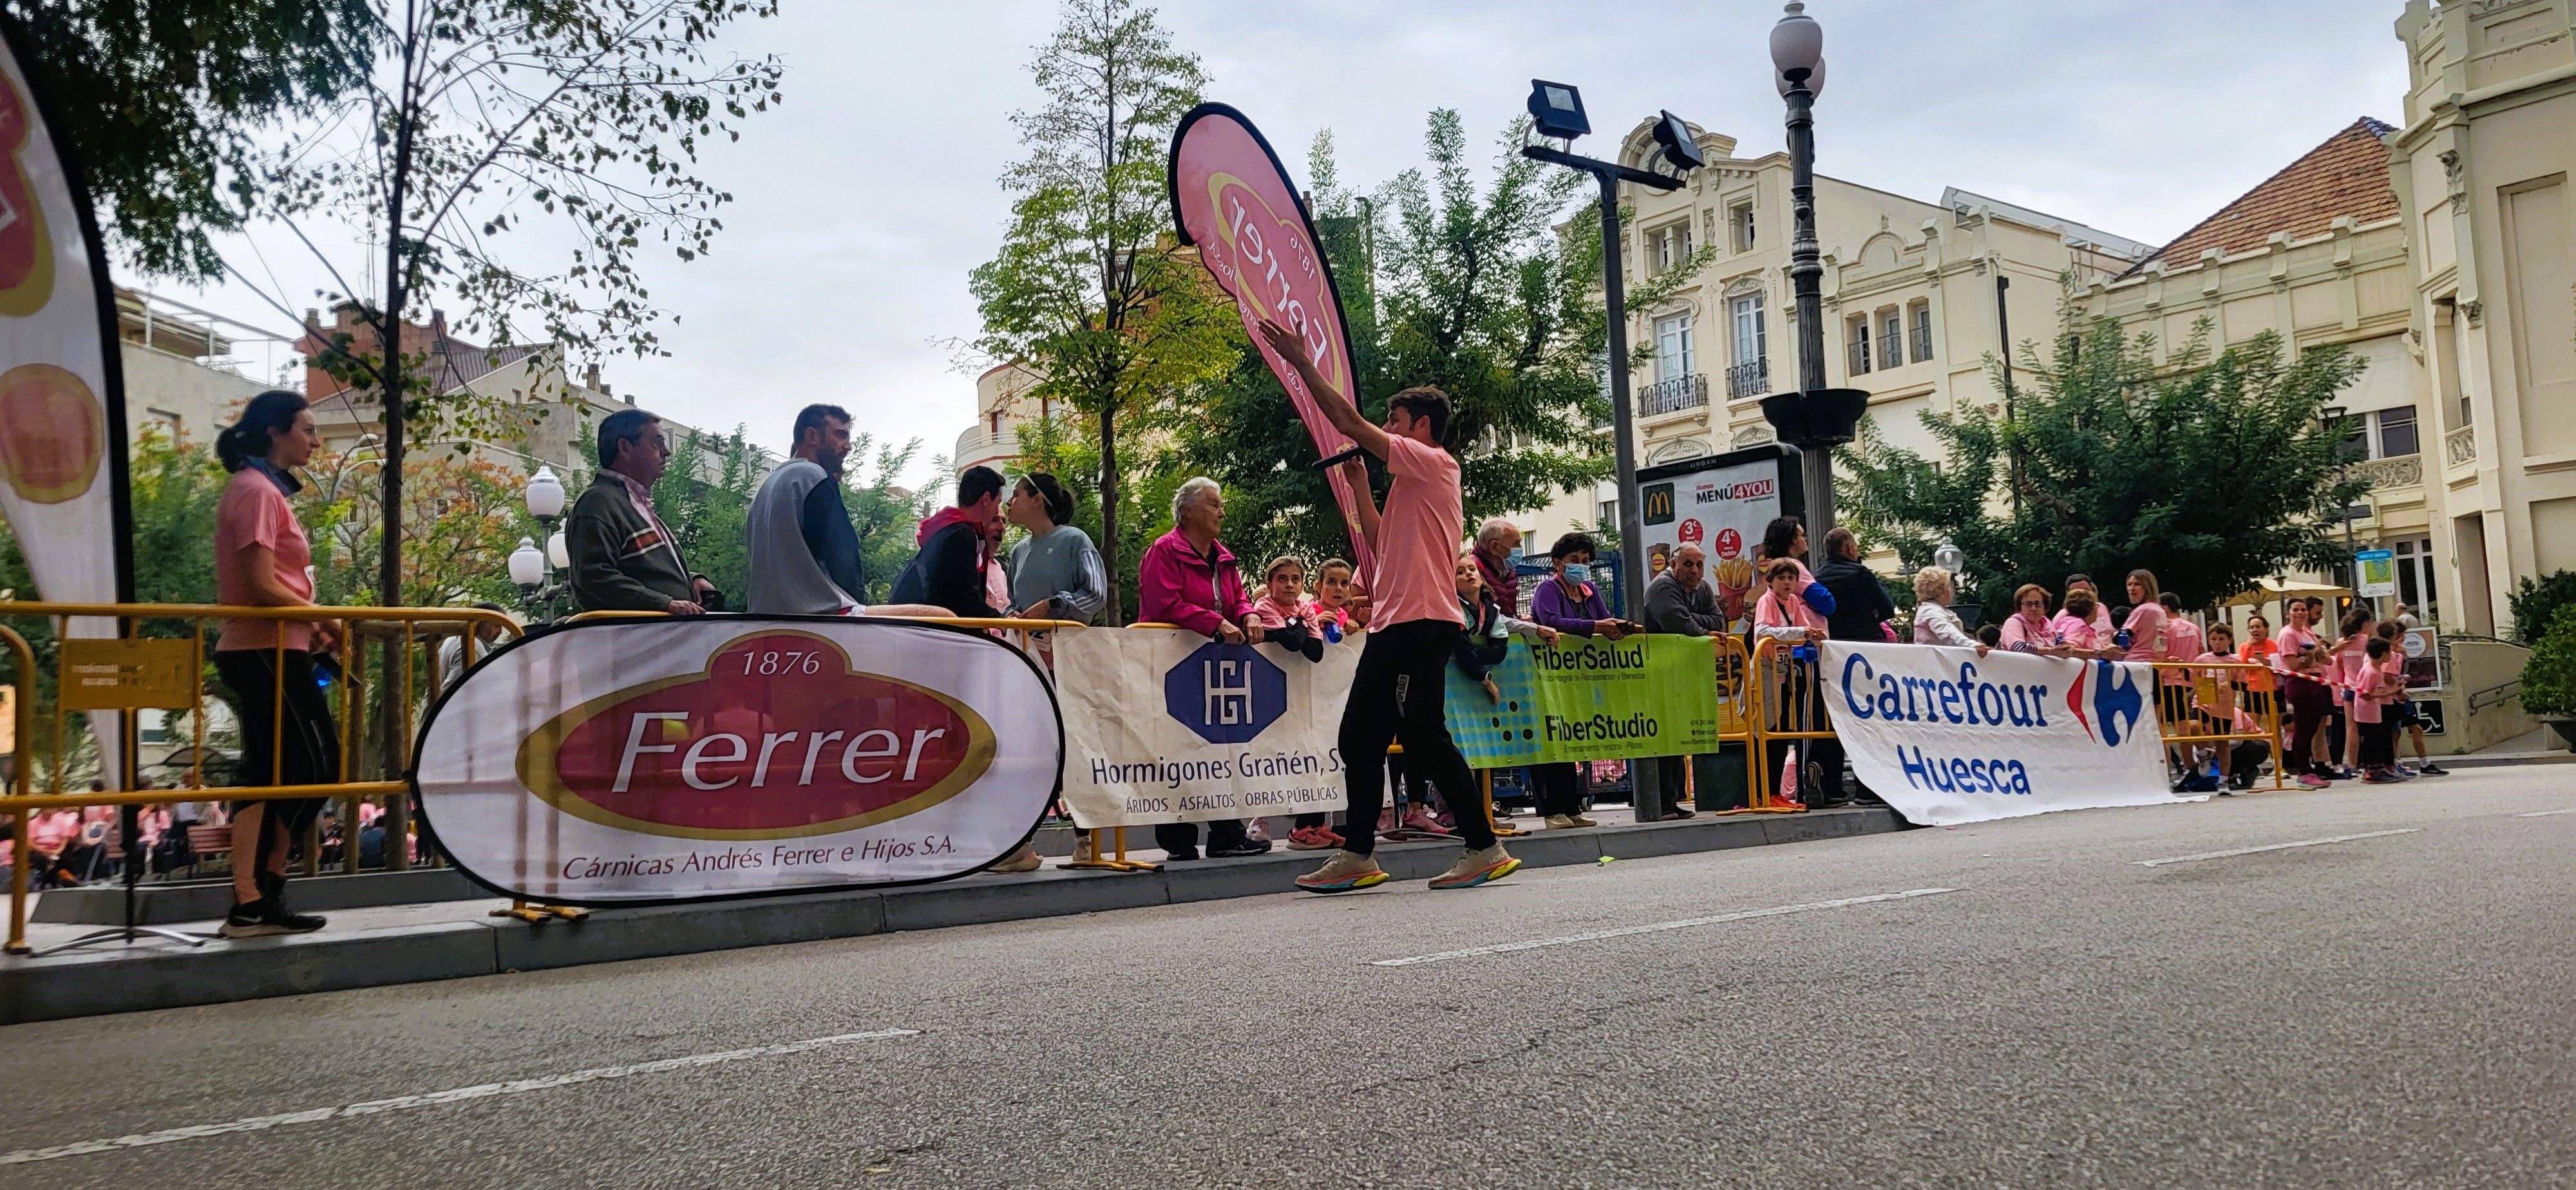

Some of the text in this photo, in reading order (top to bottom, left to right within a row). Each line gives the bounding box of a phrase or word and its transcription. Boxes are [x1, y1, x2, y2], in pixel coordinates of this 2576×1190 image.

[1690, 458, 1716, 468] URBAN
[741, 651, 820, 676] 1876
[1531, 644, 1645, 670] FiberSalud
[1841, 652, 2049, 728] Carrefour
[1545, 712, 1658, 742] FiberStudio
[611, 711, 945, 793] Ferrer
[1091, 756, 1233, 789] Hormigones
[1239, 750, 1325, 777] Grañén,
[1897, 744, 2032, 795] Huesca
[1126, 786, 1339, 814] ÁRIDOS ASFALTOS OBRAS PÚBLICAS
[564, 835, 957, 880] Cárnicas Andrés Ferrer e Hijos S.A.
